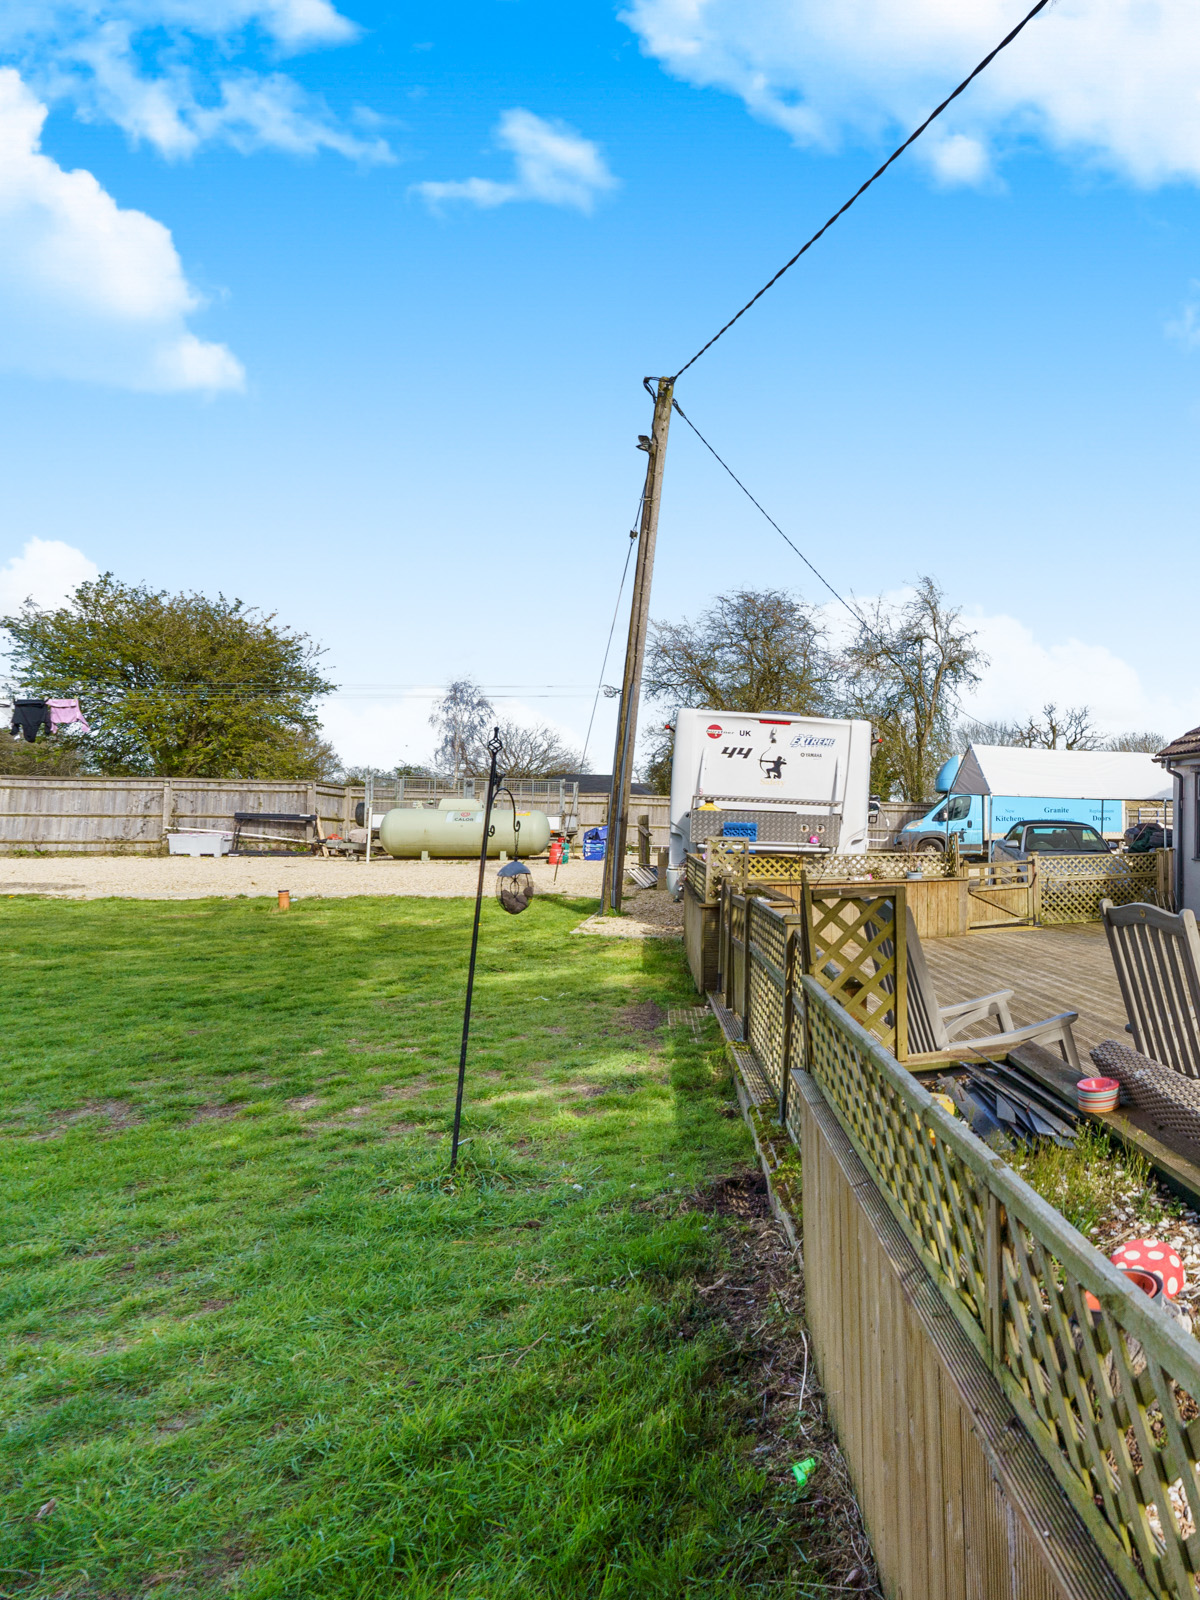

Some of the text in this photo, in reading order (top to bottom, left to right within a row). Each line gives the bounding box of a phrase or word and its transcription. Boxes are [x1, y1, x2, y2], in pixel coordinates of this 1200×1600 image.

[790, 734, 836, 747] EXTREME
[721, 746, 753, 759] 44
[1043, 806, 1070, 814] Granite
